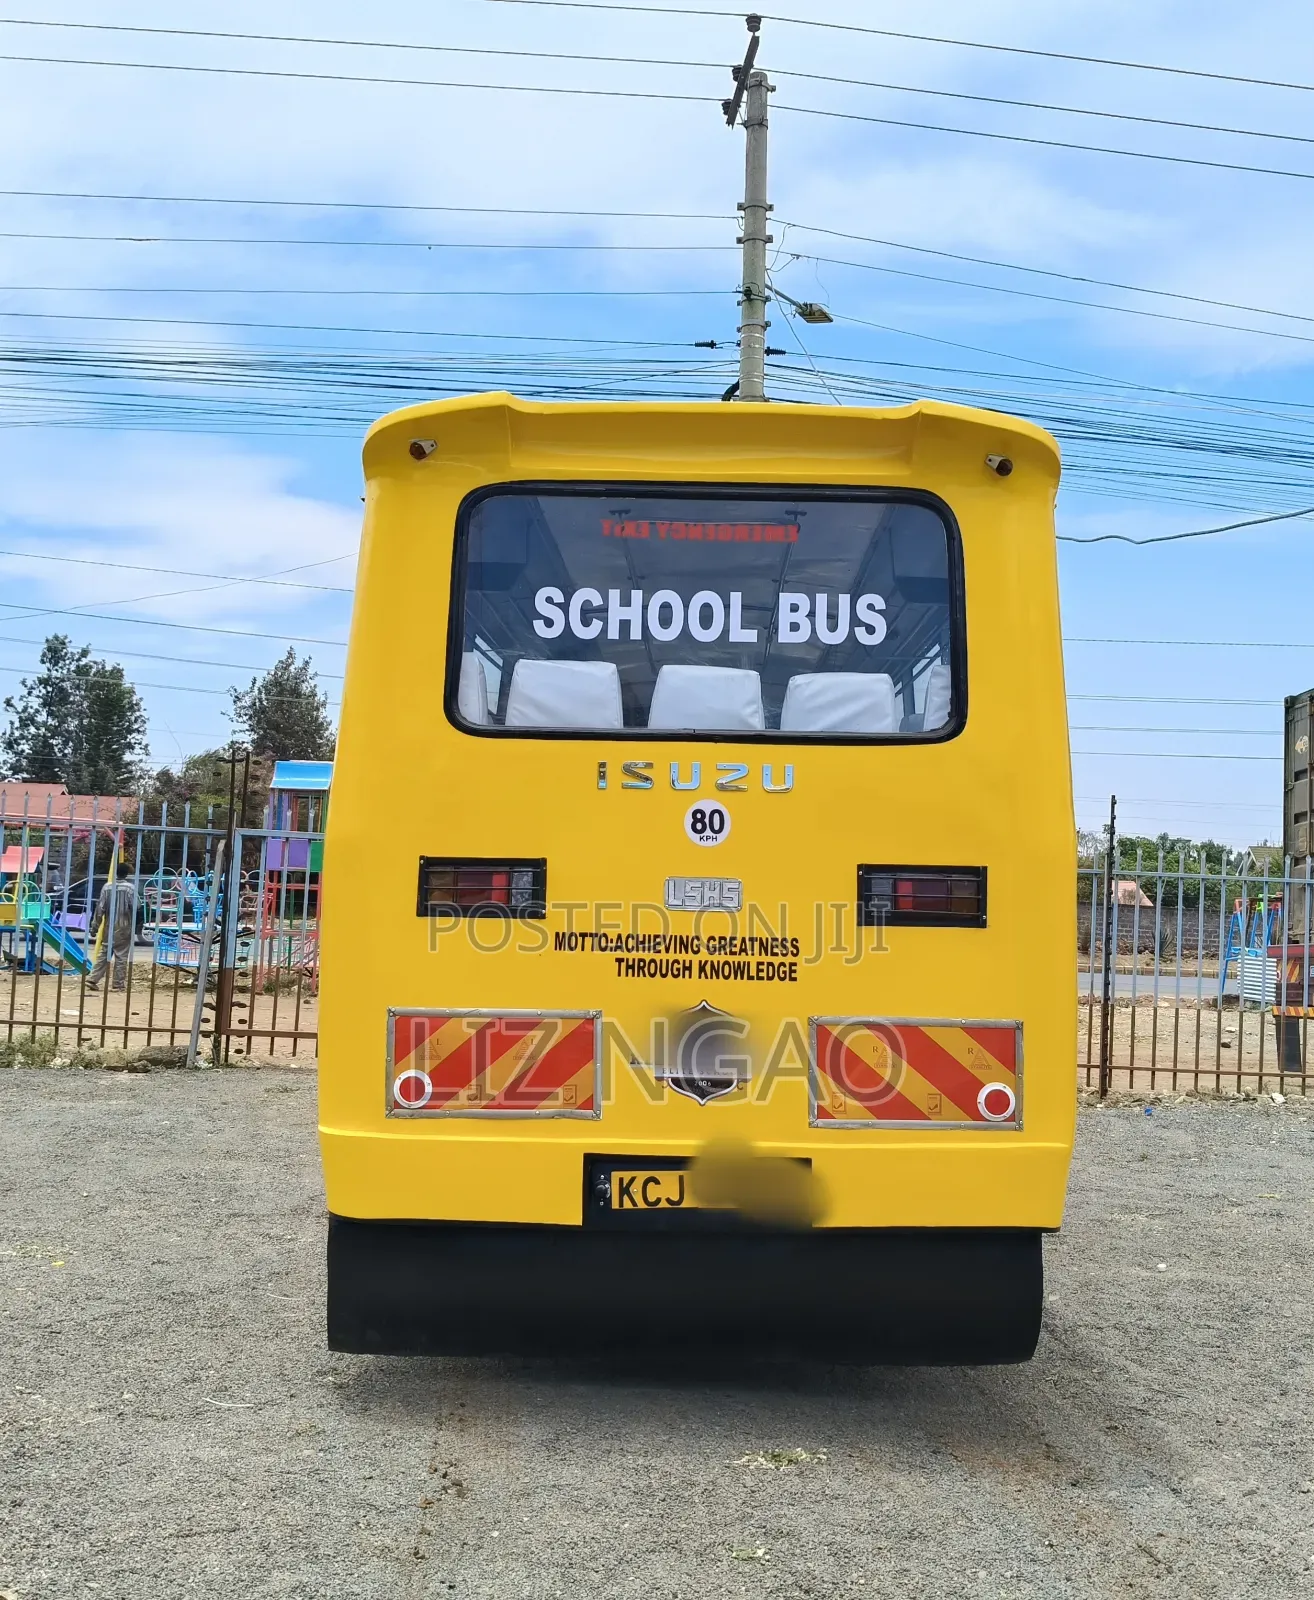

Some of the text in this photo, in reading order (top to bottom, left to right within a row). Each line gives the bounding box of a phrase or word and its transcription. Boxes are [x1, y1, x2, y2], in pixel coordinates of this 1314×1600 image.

[532, 586, 887, 646] SCHOOL BUS
[597, 761, 794, 793] ISUZU
[690, 808, 725, 835] 80
[667, 879, 740, 908] LSHS
[706, 936, 800, 958] GREATNESS
[615, 957, 798, 982] THROUGH KNOWLEDGE
[618, 1174, 685, 1208] KCJ
